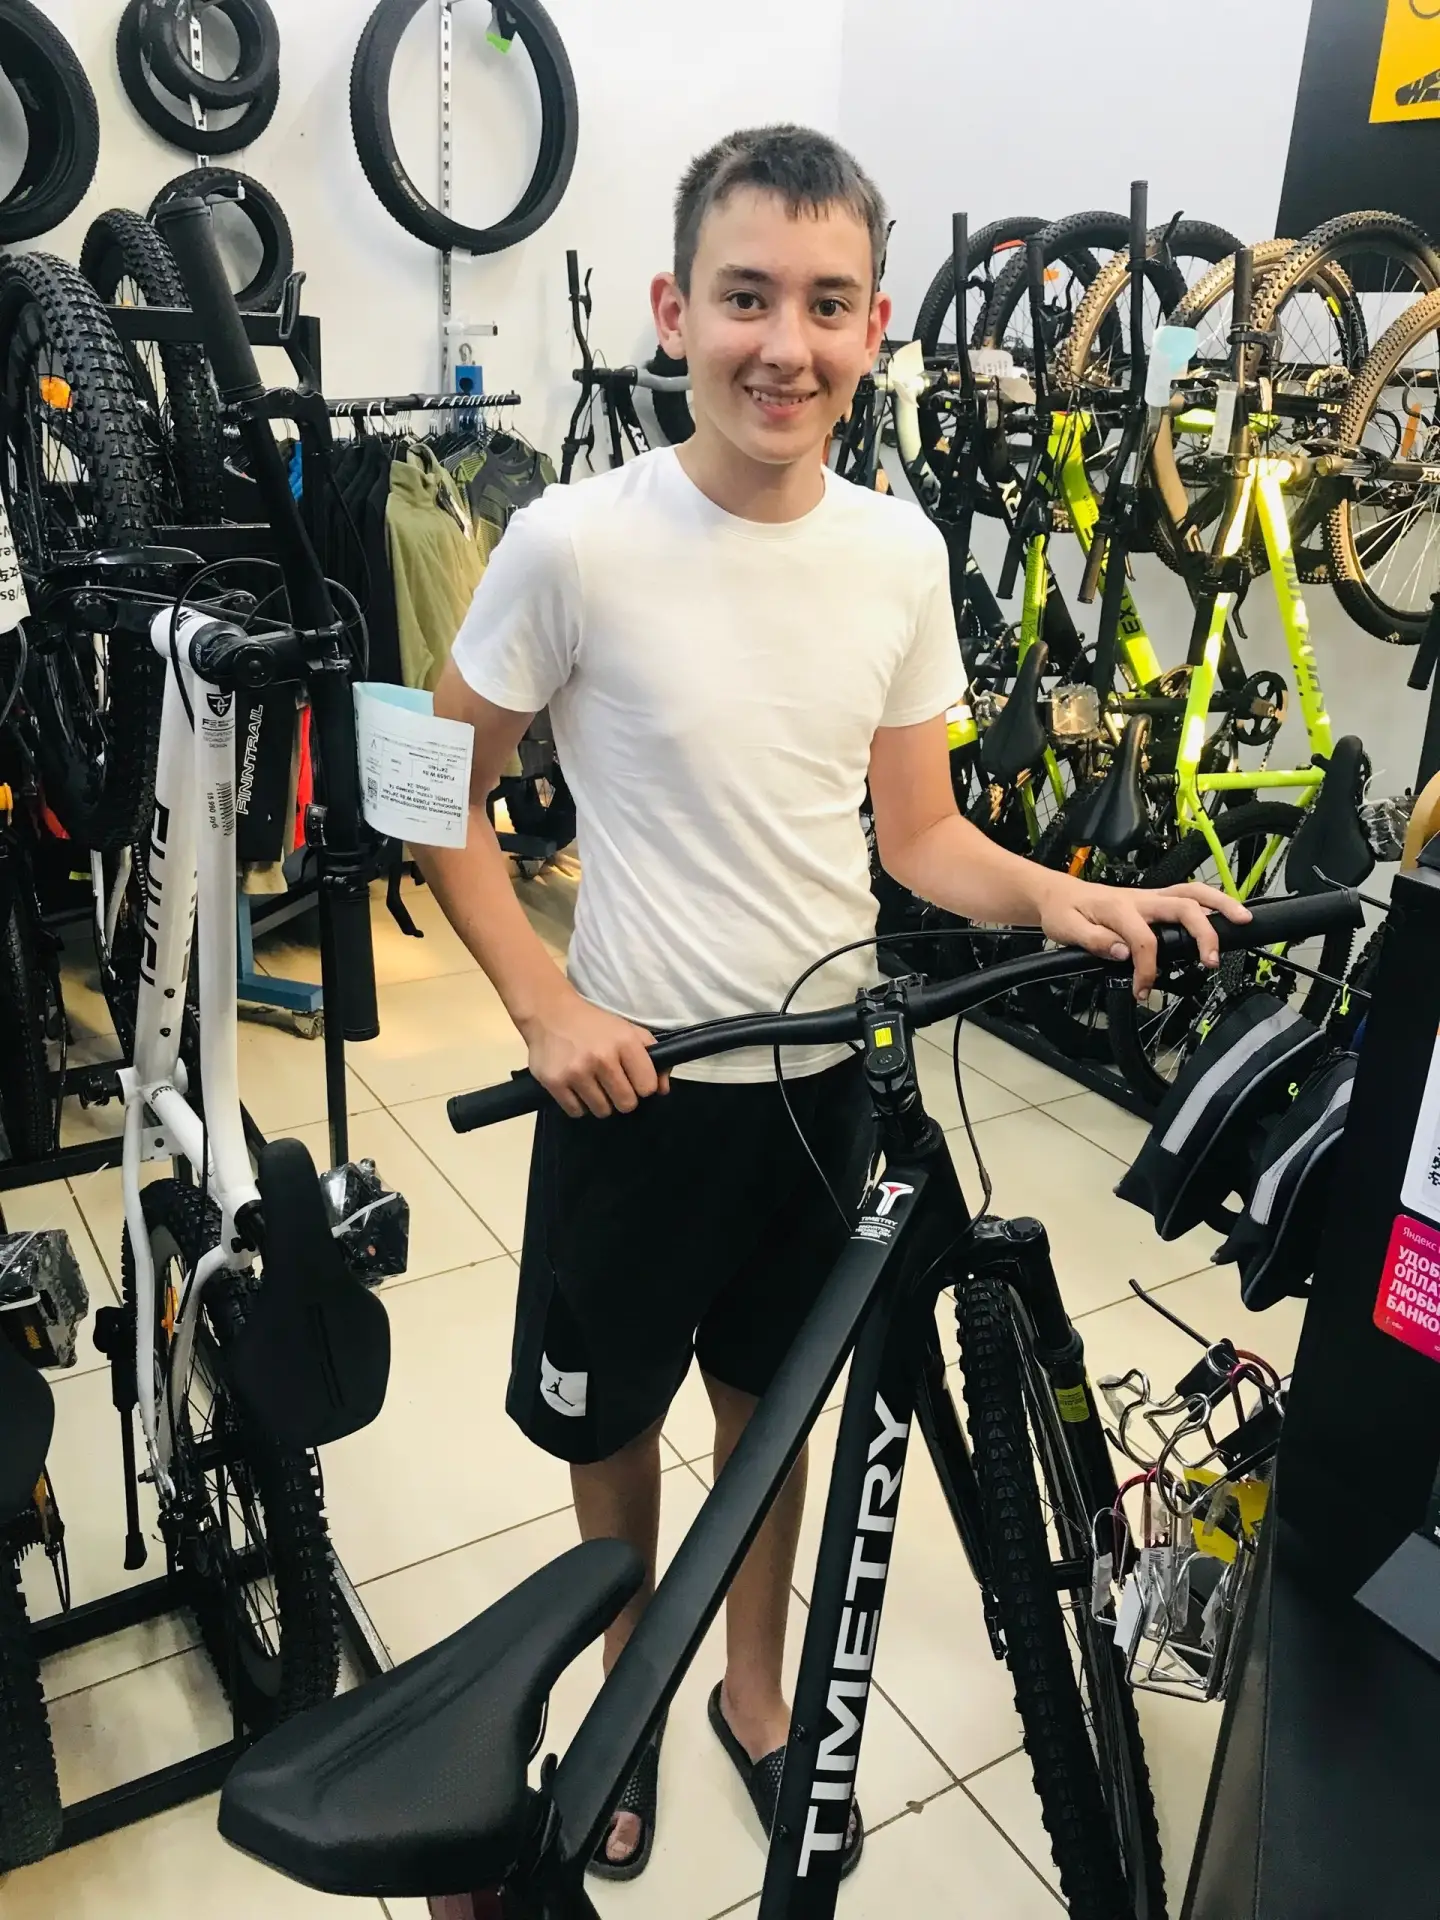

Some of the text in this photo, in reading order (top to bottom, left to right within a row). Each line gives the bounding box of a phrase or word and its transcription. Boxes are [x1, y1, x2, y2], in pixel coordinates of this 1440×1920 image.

[236, 704, 264, 815] FINNTRAIL
[1403, 1226, 1437, 1252] Яндекс
[1398, 1245, 1440, 1279] УДОБ
[1386, 1294, 1440, 1336] БАНКО
[797, 1391, 909, 1877] TIMETRY
